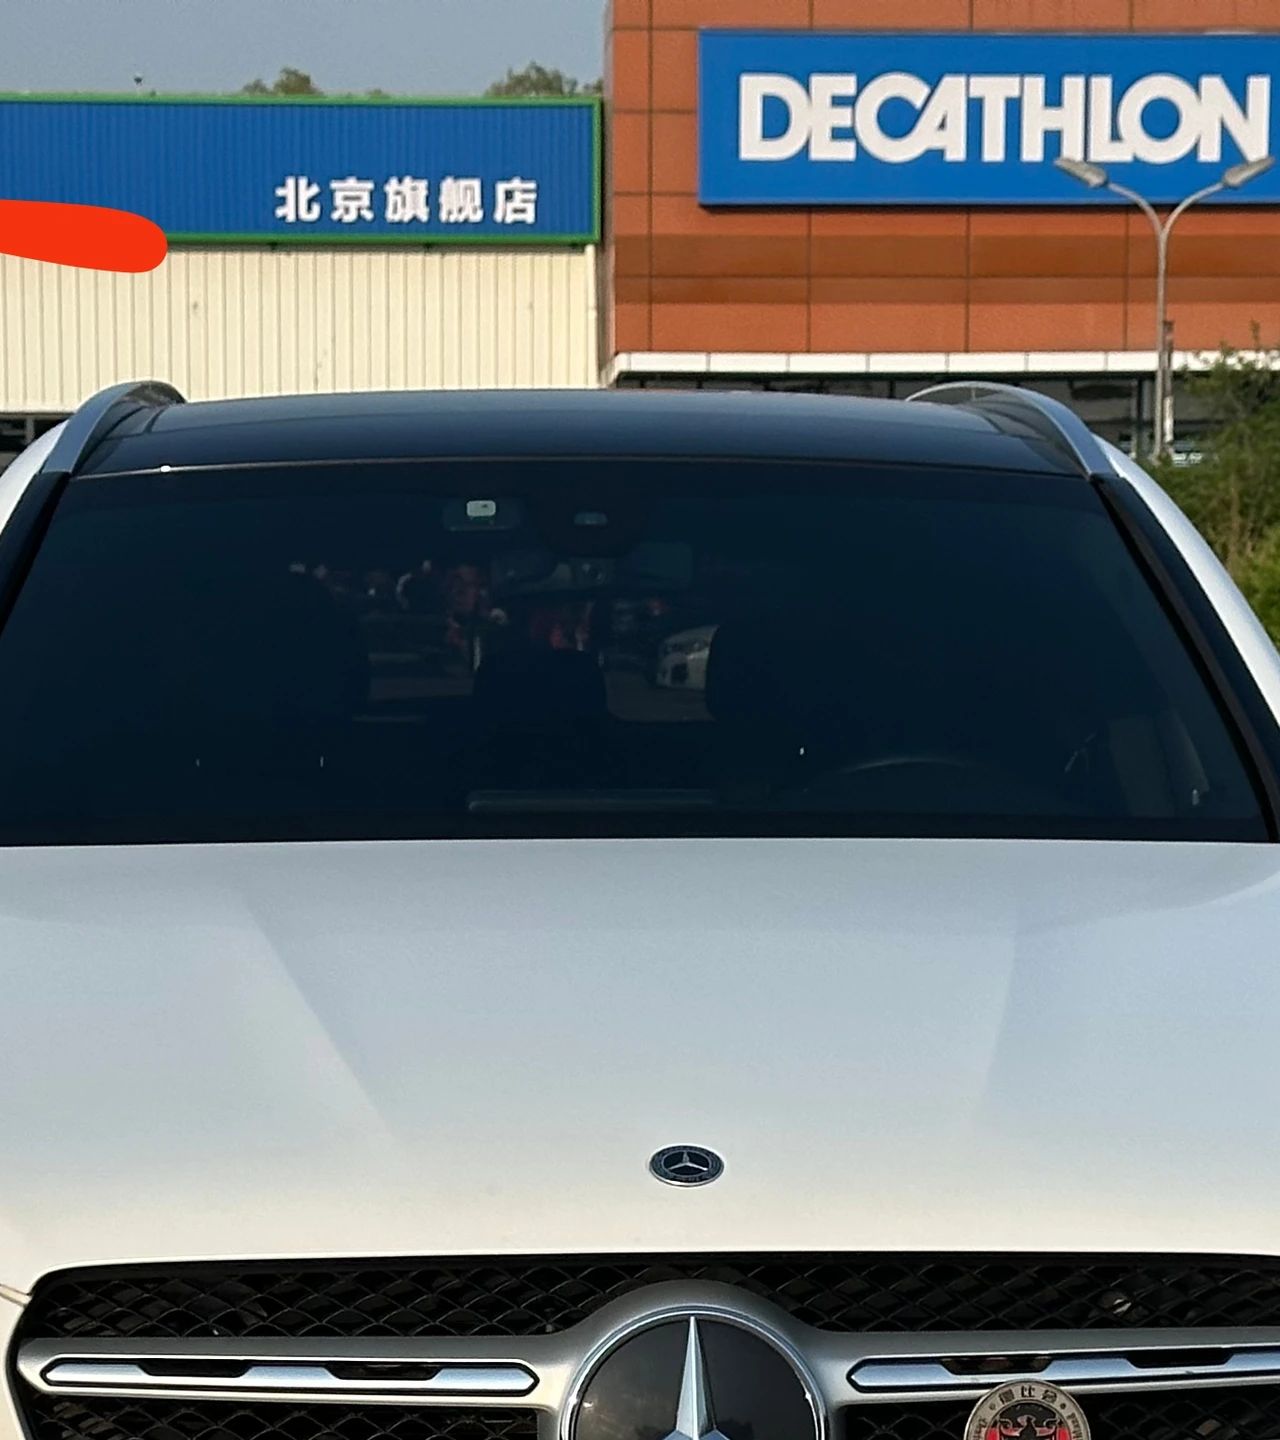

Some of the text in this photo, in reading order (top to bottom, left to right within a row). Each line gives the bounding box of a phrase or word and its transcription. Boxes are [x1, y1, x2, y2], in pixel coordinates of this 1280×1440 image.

[738, 72, 1272, 165] DECATHLON
[274, 175, 538, 224] 北京旗舰店
